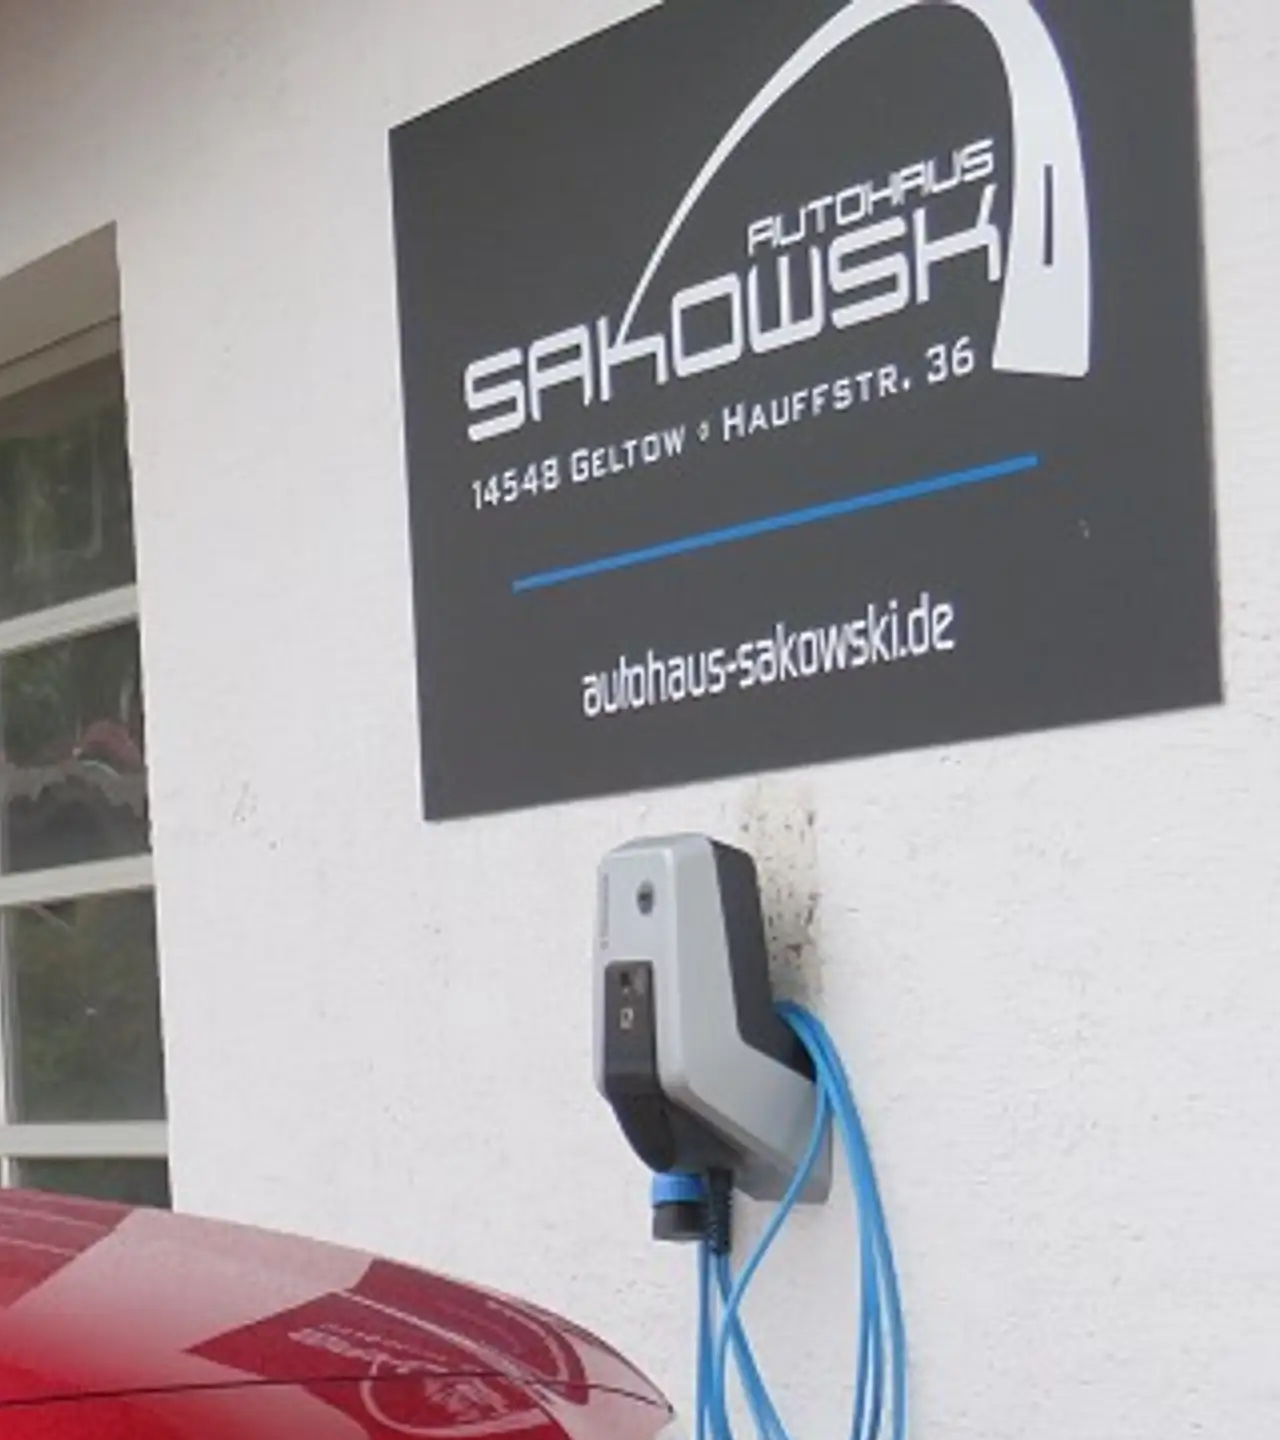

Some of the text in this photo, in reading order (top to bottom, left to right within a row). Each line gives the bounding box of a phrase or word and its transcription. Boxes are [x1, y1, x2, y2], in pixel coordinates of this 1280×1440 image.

[747, 138, 996, 257] AUTOHAUS
[471, 456, 561, 511] 14548
[925, 335, 976, 385] 36
[581, 592, 956, 717] autohaus-sakowski.de
